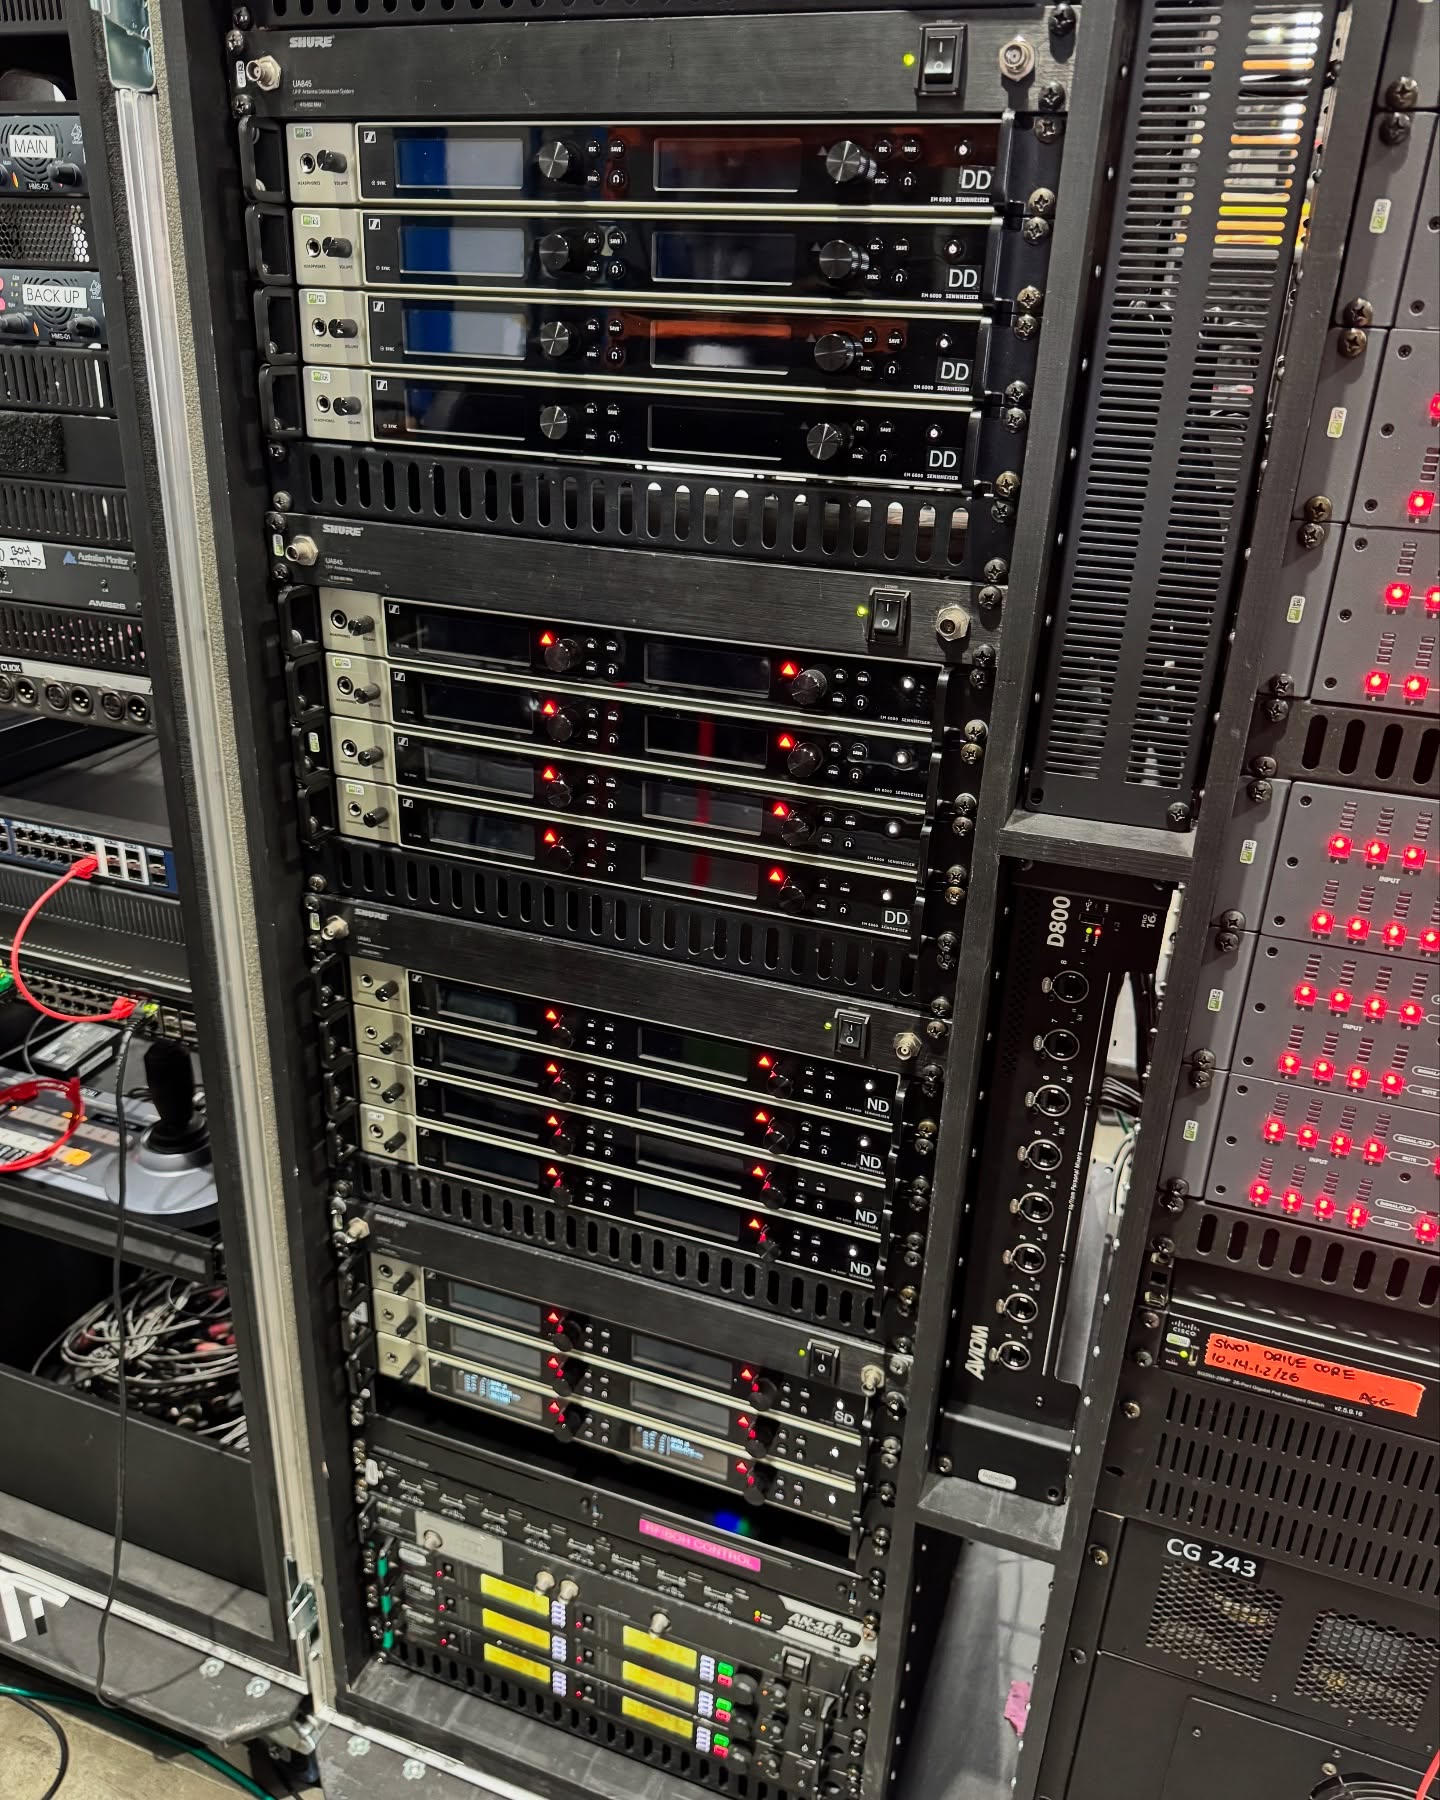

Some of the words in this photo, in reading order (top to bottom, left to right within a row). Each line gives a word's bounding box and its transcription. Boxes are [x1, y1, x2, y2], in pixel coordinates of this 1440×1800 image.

[289, 36, 333, 48] SHURE
[292, 80, 312, 88] UA845
[14, 139, 48, 153] MAIN
[961, 169, 991, 190] DD
[949, 269, 978, 288] DD
[27, 288, 60, 302] BACK
[64, 290, 80, 303] UP
[941, 362, 969, 381] DD
[929, 450, 957, 468] DD
[322, 524, 362, 536] SHURE
[1, 663, 21, 672] CLICK
[1379, 876, 1401, 884] INPUT
[884, 910, 908, 925] DD
[1046, 896, 1071, 947] D800
[1342, 1023, 1363, 1032] INPUT
[867, 1097, 889, 1112] ND
[860, 1154, 882, 1169] ND
[1309, 1156, 1329, 1165] INPUT
[1070, 1168, 1080, 1191] Personal
[855, 1209, 877, 1223] ND
[850, 1261, 871, 1276] ND
[1172, 1326, 1197, 1337] CISCO
[964, 1324, 989, 1381] AVIOM
[1263, 1351, 1307, 1369] DRIVE
[1314, 1363, 1356, 1380] CORE
[1358, 1393, 1395, 1408] AGG
[834, 1411, 855, 1426] SD
[1166, 1538, 1201, 1562] CG
[1207, 1550, 1257, 1578] 243
